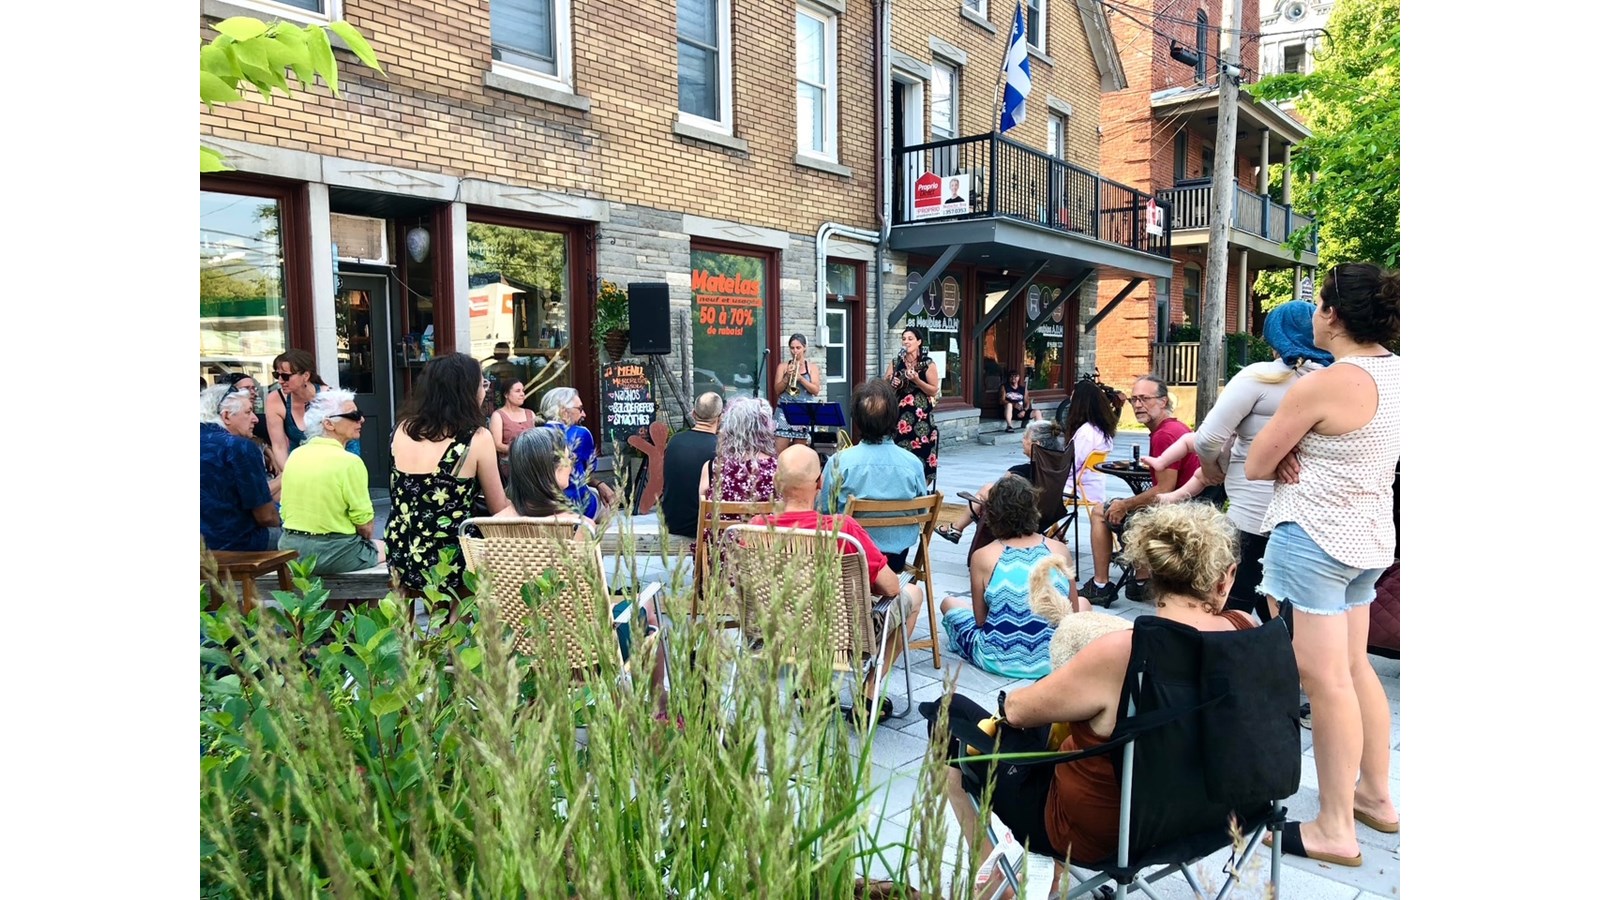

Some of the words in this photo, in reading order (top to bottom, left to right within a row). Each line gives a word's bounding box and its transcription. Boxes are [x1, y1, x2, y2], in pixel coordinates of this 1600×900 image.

[917, 182, 939, 191] Proprio
[692, 269, 760, 296] Matelas
[699, 306, 716, 324] 50
[718, 305, 728, 325] à
[730, 307, 754, 326] 70%
[706, 325, 717, 335] de
[617, 365, 643, 376] MENU
